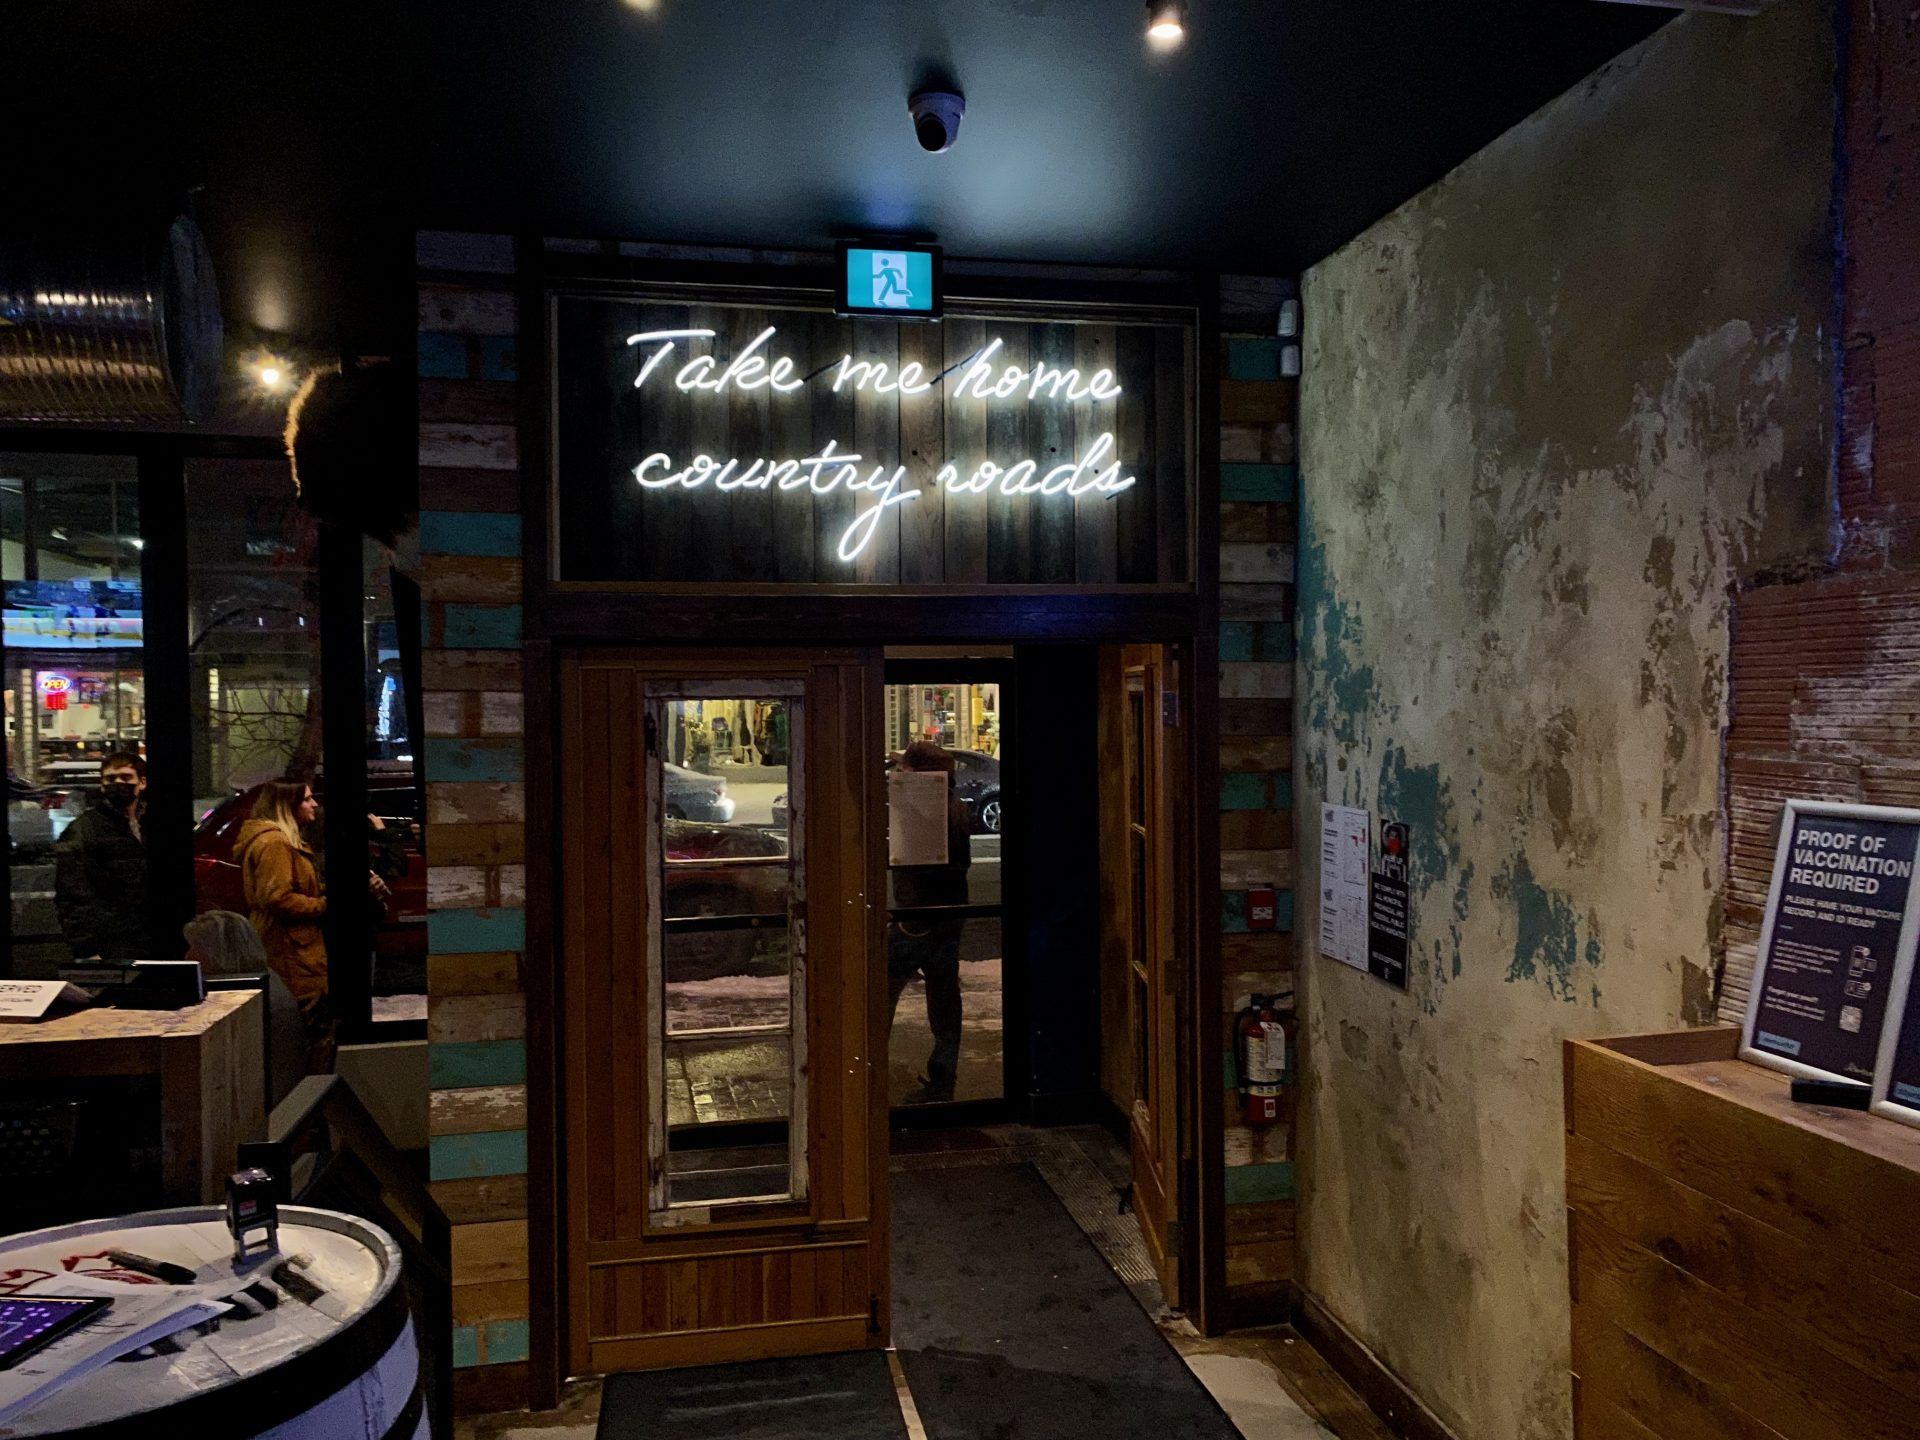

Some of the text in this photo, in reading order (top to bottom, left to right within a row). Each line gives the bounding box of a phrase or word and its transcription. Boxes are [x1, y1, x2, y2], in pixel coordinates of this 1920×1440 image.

[626, 326, 1123, 400] Take me home
[634, 432, 1137, 563] country roads
[44, 679, 67, 690] OPEN
[1797, 829, 1887, 853] PROOF OF
[1794, 848, 1912, 878] VACCINATION
[1789, 867, 1880, 895] REQUIRED
[1782, 906, 1817, 918] RECORD
[1817, 912, 1835, 922] AND
[1846, 916, 1877, 928] READY
[1785, 894, 1816, 906] PLEASE
[1840, 903, 1864, 914] YOUR
